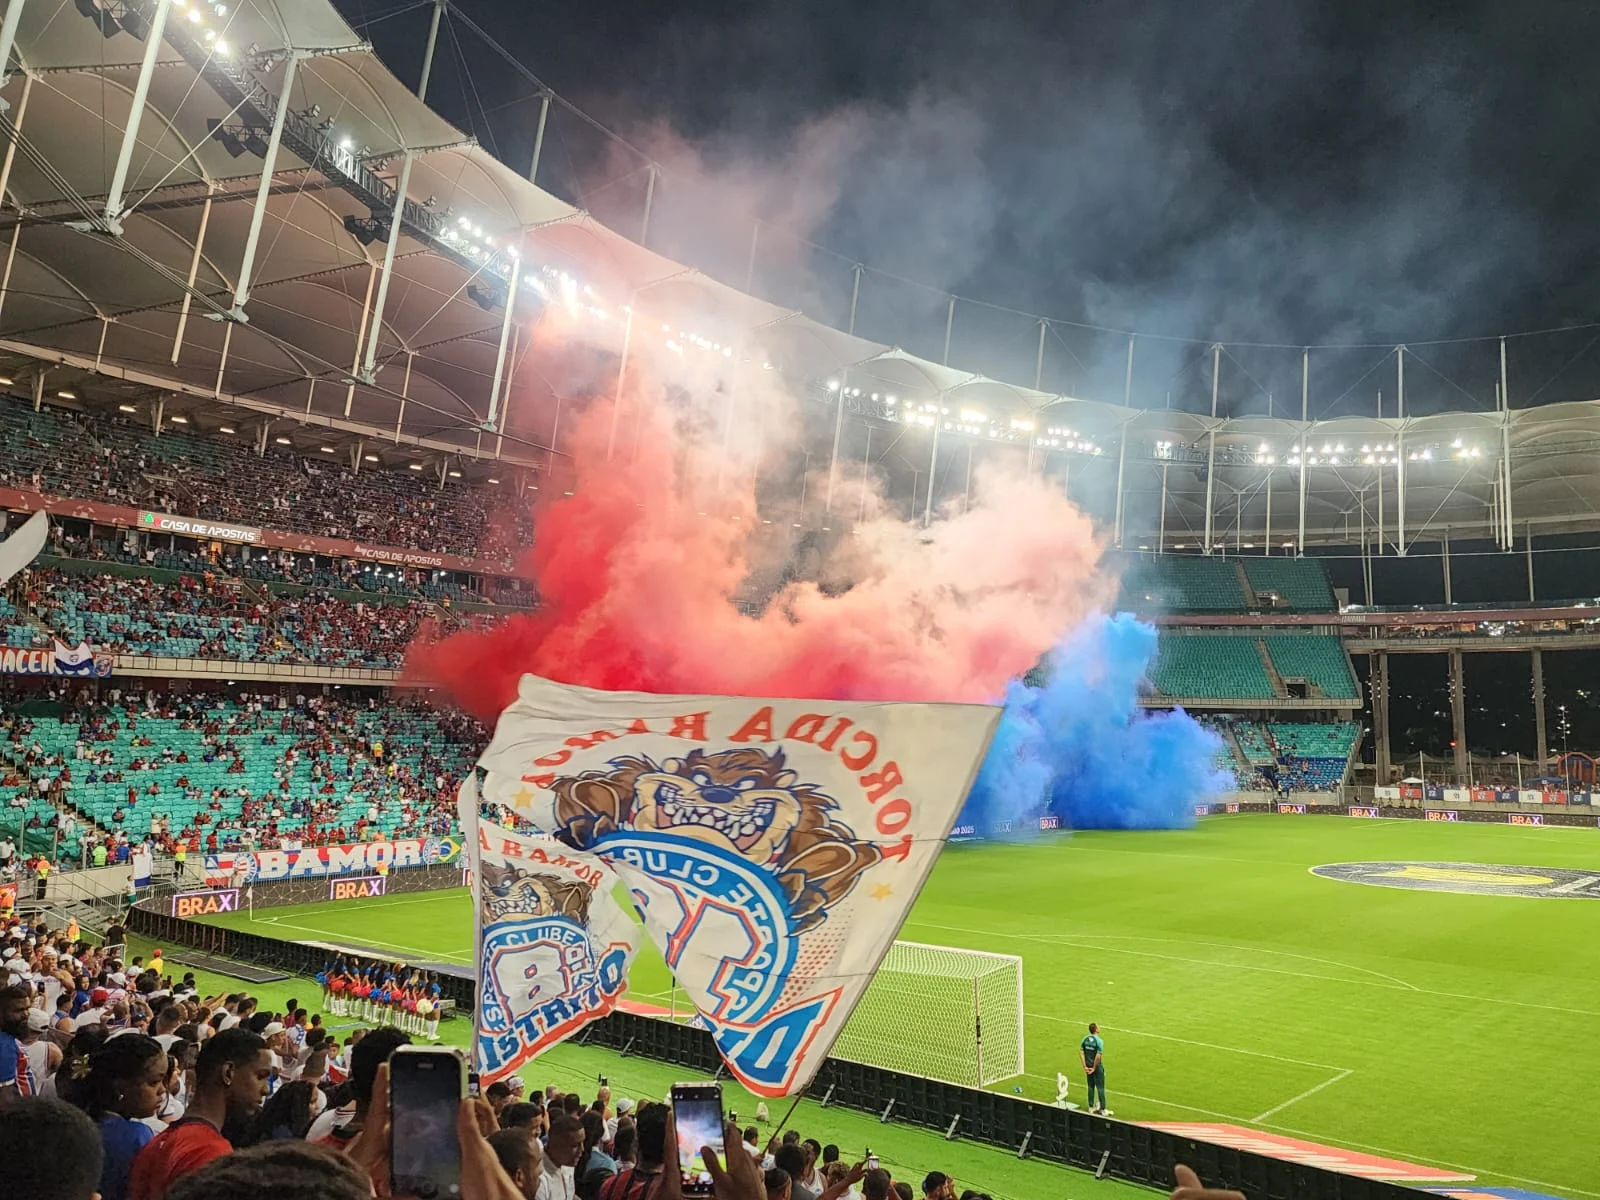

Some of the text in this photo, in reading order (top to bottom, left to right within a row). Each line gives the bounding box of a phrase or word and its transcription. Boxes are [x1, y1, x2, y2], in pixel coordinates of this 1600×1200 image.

[160, 519, 256, 541] CASA DE APOSTAS
[366, 549, 442, 566] CASA DE APOSTAS
[1280, 806, 1304, 814] BRAX
[1351, 808, 1376, 817] BRAX
[1429, 812, 1455, 822] BRAX
[1511, 815, 1540, 825] BRAX
[257, 840, 423, 878] BAMOR
[336, 879, 381, 900] BRAX
[178, 894, 233, 917] BRAX
[478, 949, 628, 1073] ISTRITO
